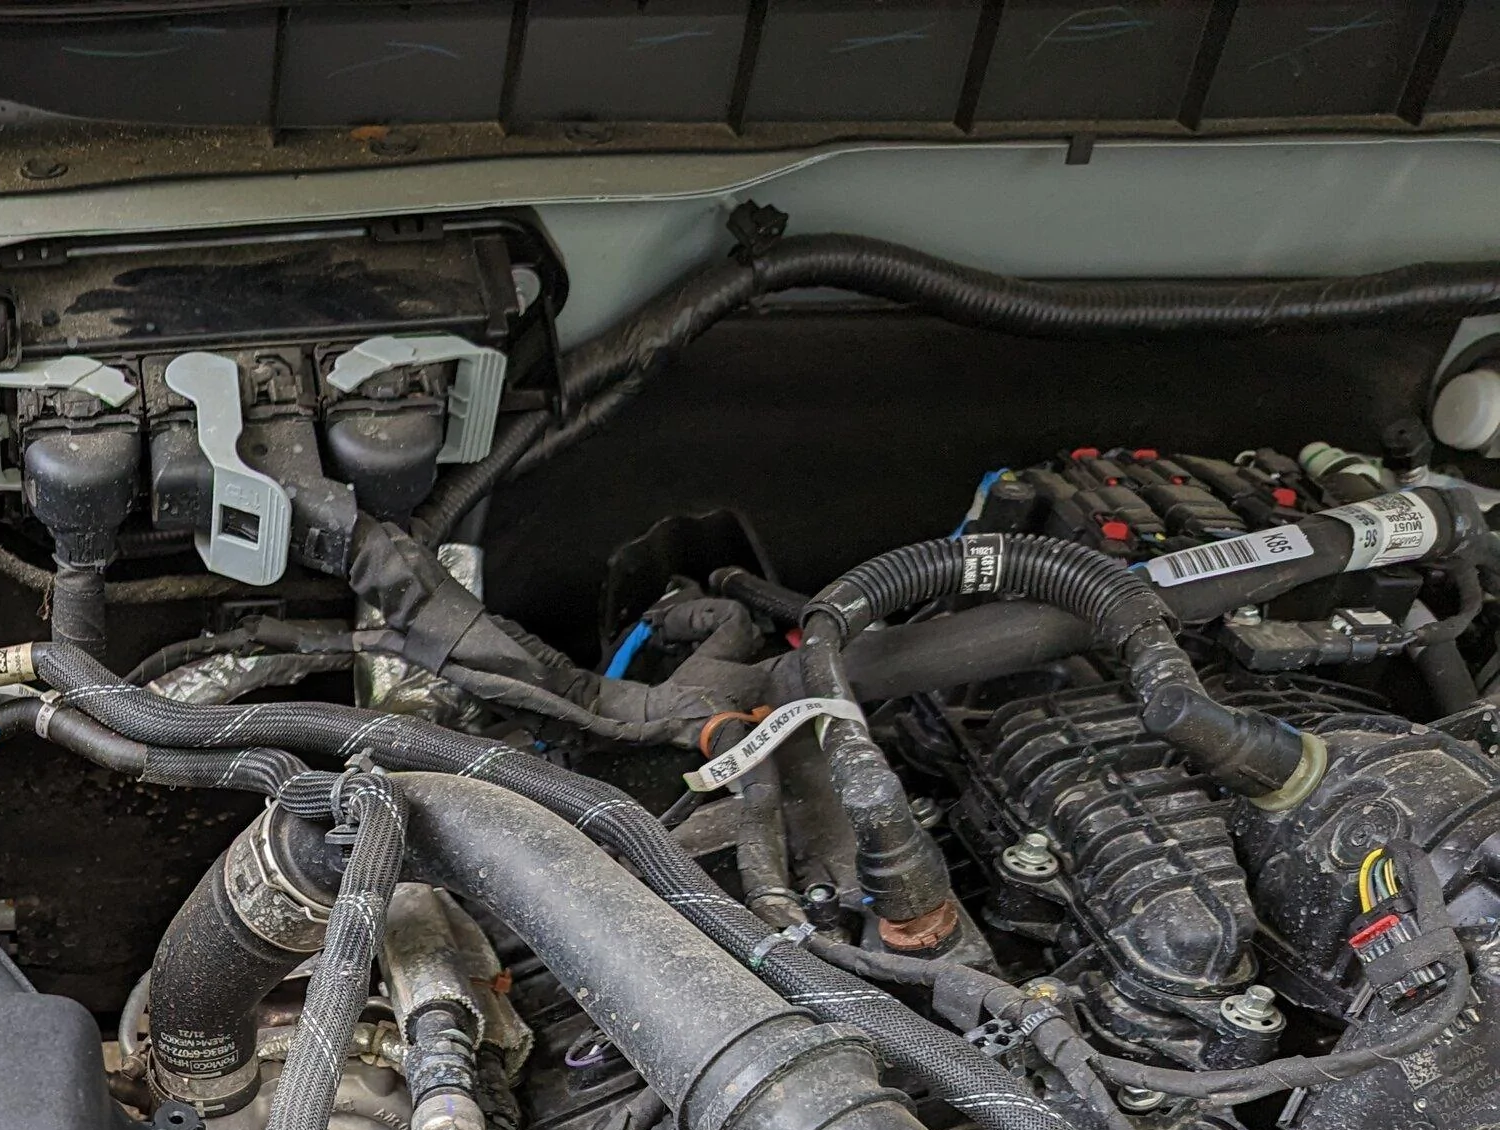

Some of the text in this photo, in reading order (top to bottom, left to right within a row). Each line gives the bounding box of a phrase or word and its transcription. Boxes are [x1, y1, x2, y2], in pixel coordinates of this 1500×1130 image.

[1392, 520, 1423, 533] MU5T
[1262, 533, 1292, 554] K85
[741, 728, 771, 757] ML3E
[768, 705, 801, 733] 6K817
[193, 1056, 236, 1071] FoMoCo
